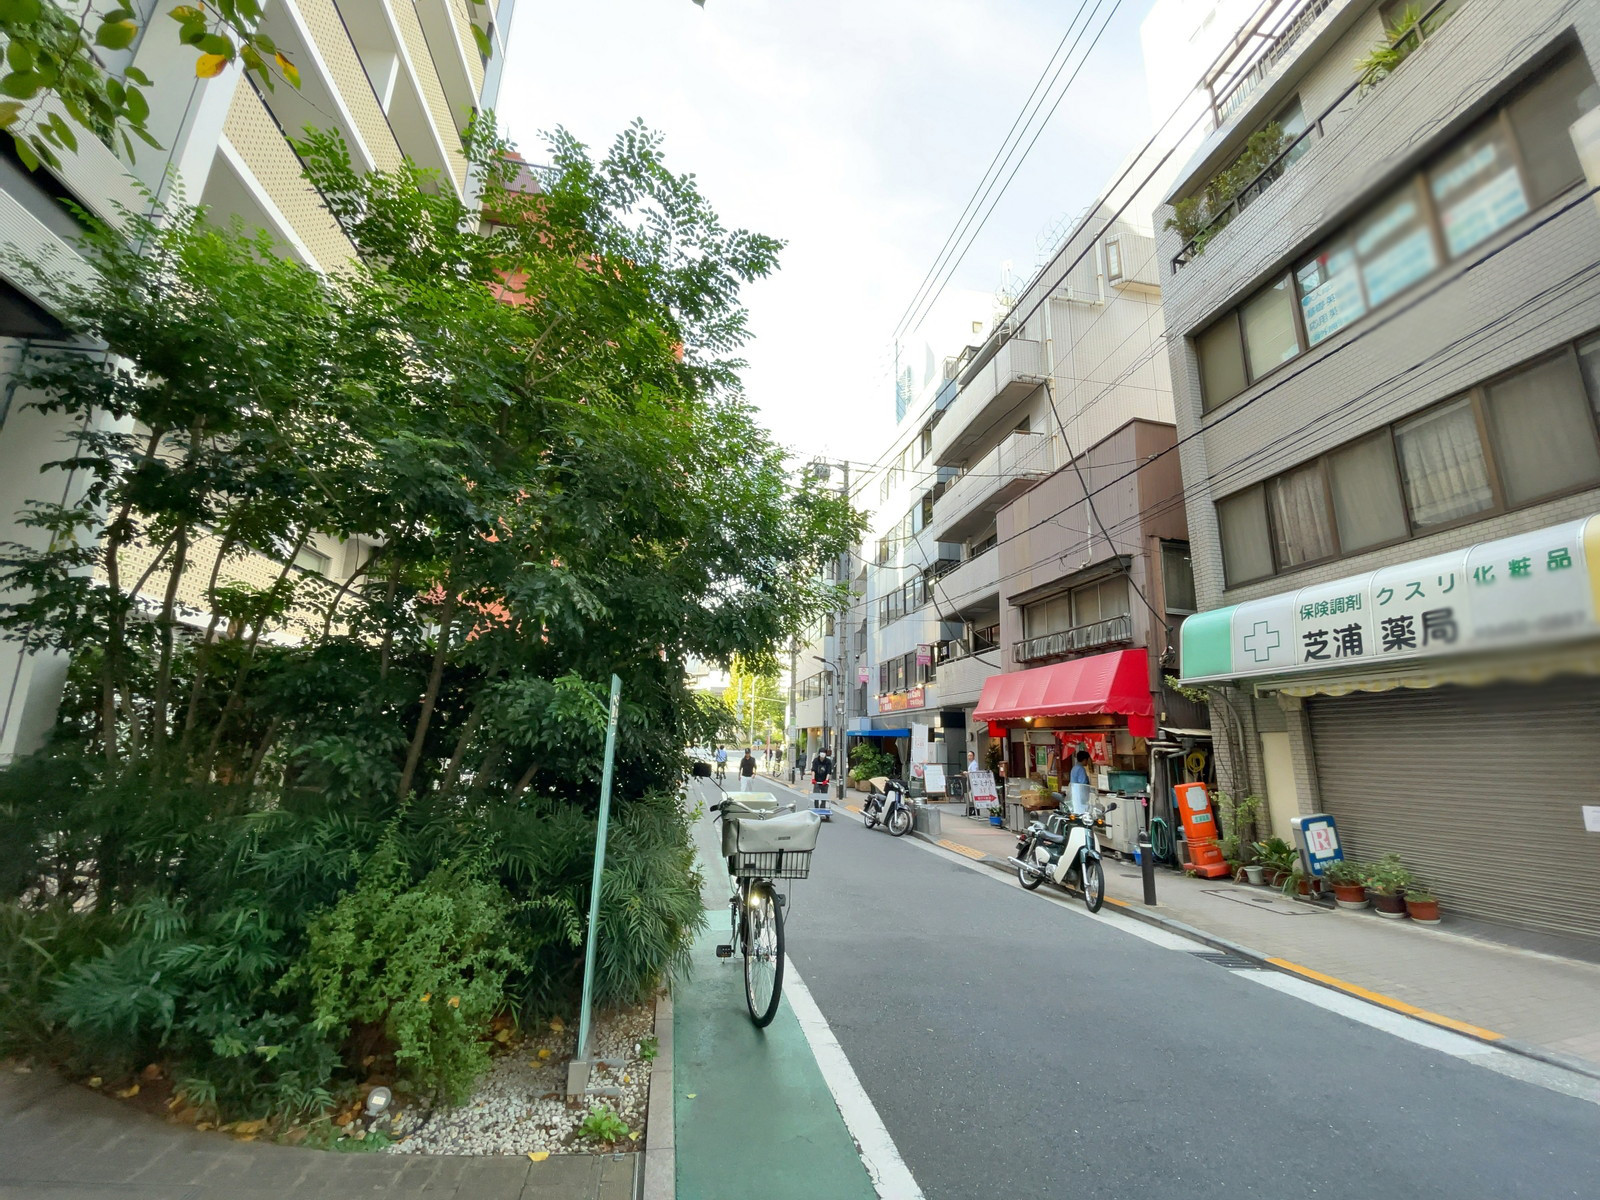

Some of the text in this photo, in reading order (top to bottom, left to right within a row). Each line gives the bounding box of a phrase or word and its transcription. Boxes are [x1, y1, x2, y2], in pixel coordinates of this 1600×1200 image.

[1299, 547, 1572, 621] 保険調剤 クスリ 化粧品
[1302, 606, 1459, 663] 芝浦薬局
